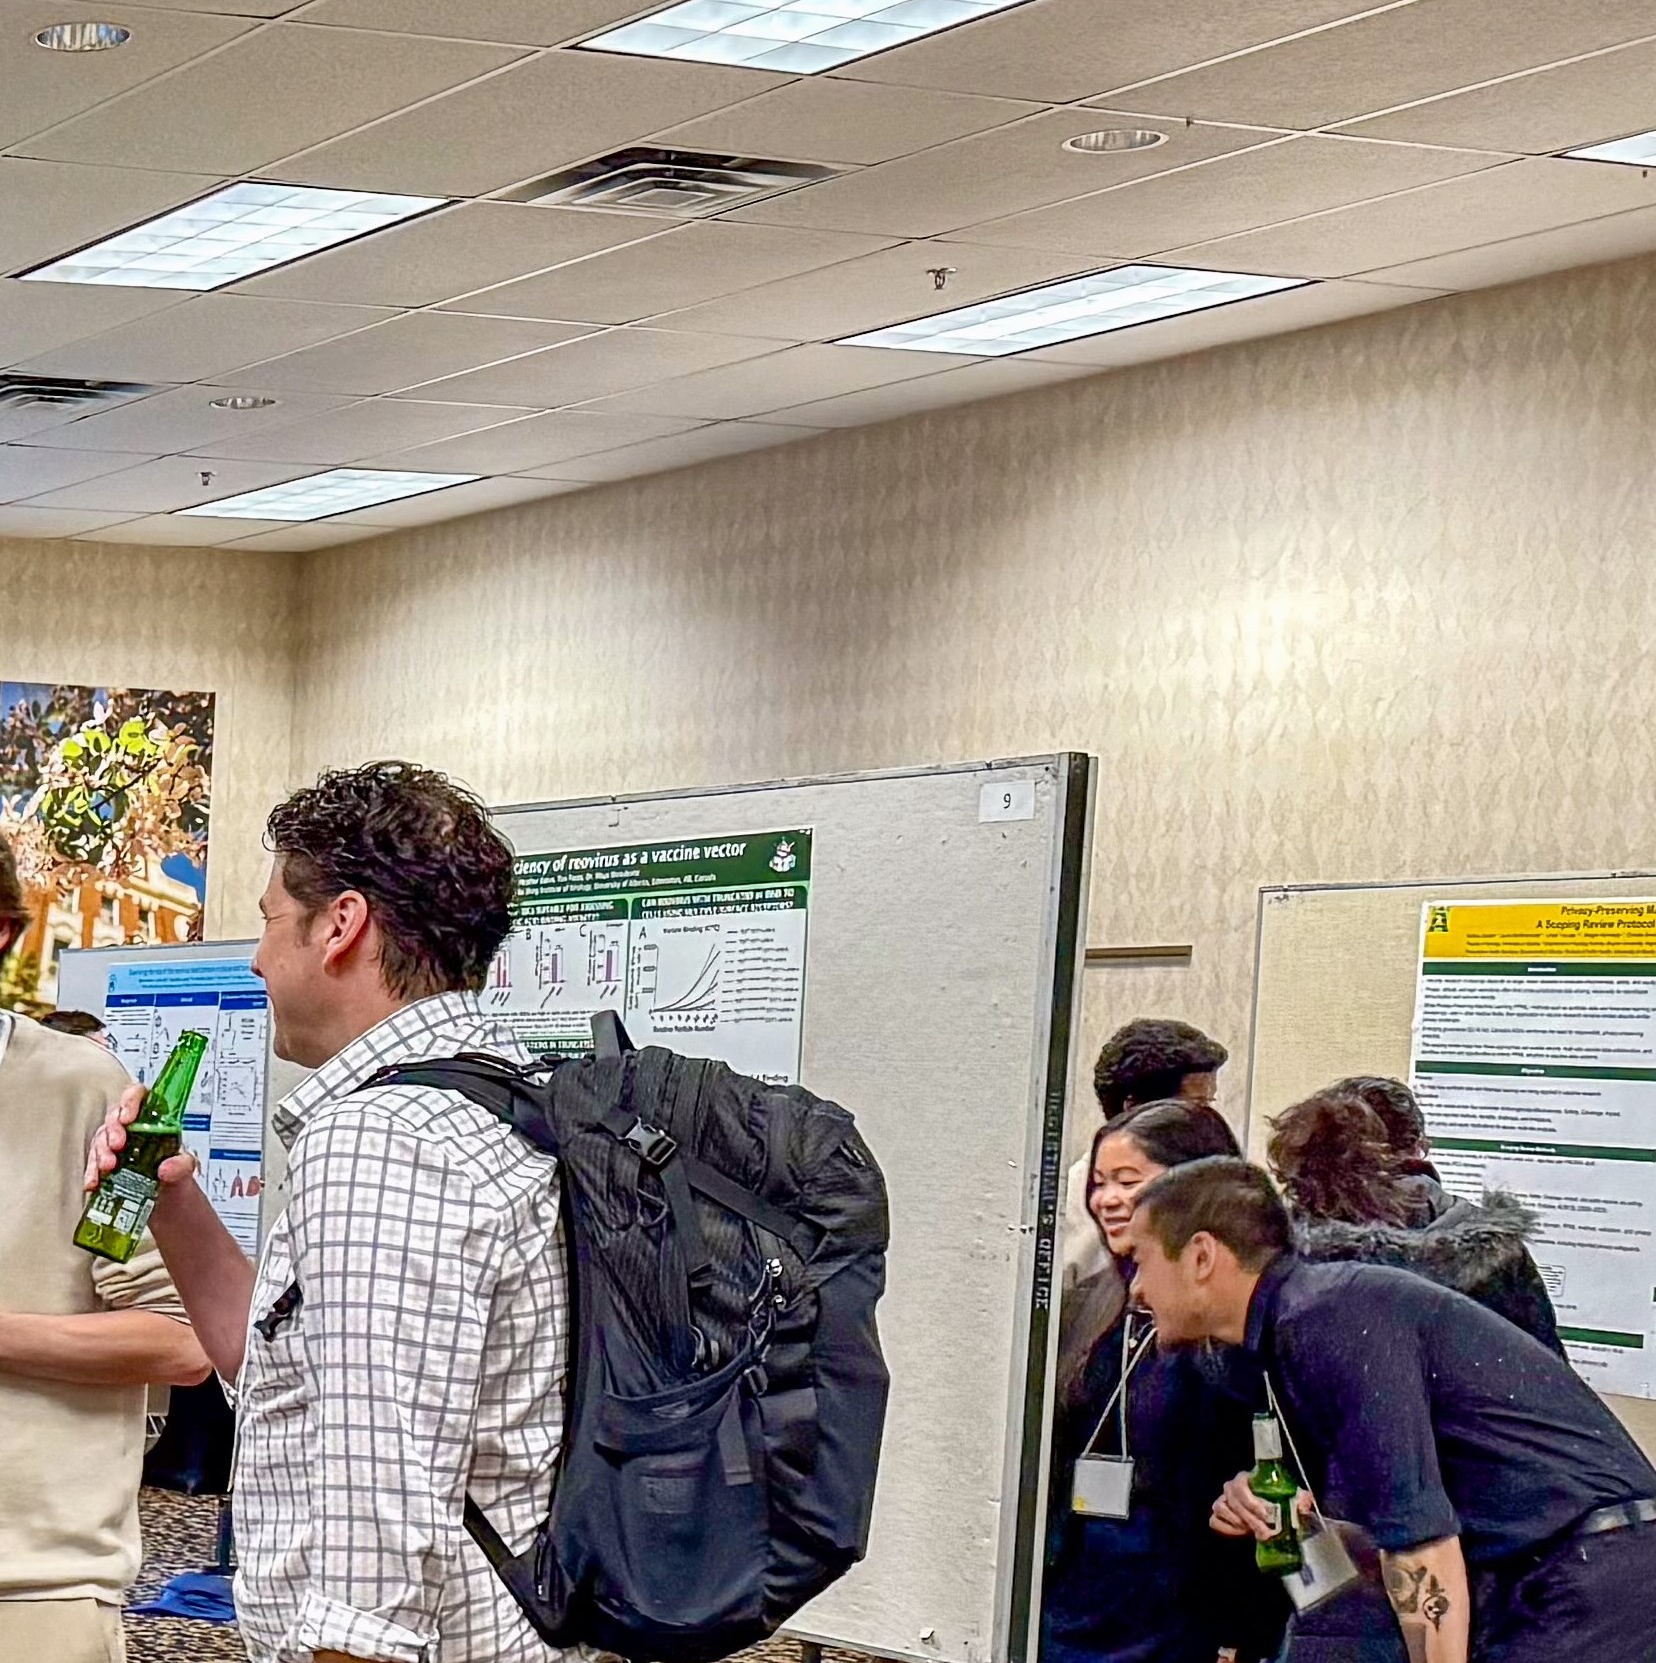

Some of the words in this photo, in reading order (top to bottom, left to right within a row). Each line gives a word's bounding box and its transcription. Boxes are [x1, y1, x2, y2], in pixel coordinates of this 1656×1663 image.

[1003, 793, 1012, 810] 9
[552, 854, 567, 872] of
[568, 852, 619, 871] reovirus
[622, 852, 637, 866] as
[640, 851, 648, 865] a
[652, 844, 701, 863] vaccine
[703, 842, 747, 859] vector
[1035, 1237, 1053, 1310] OFFICE
